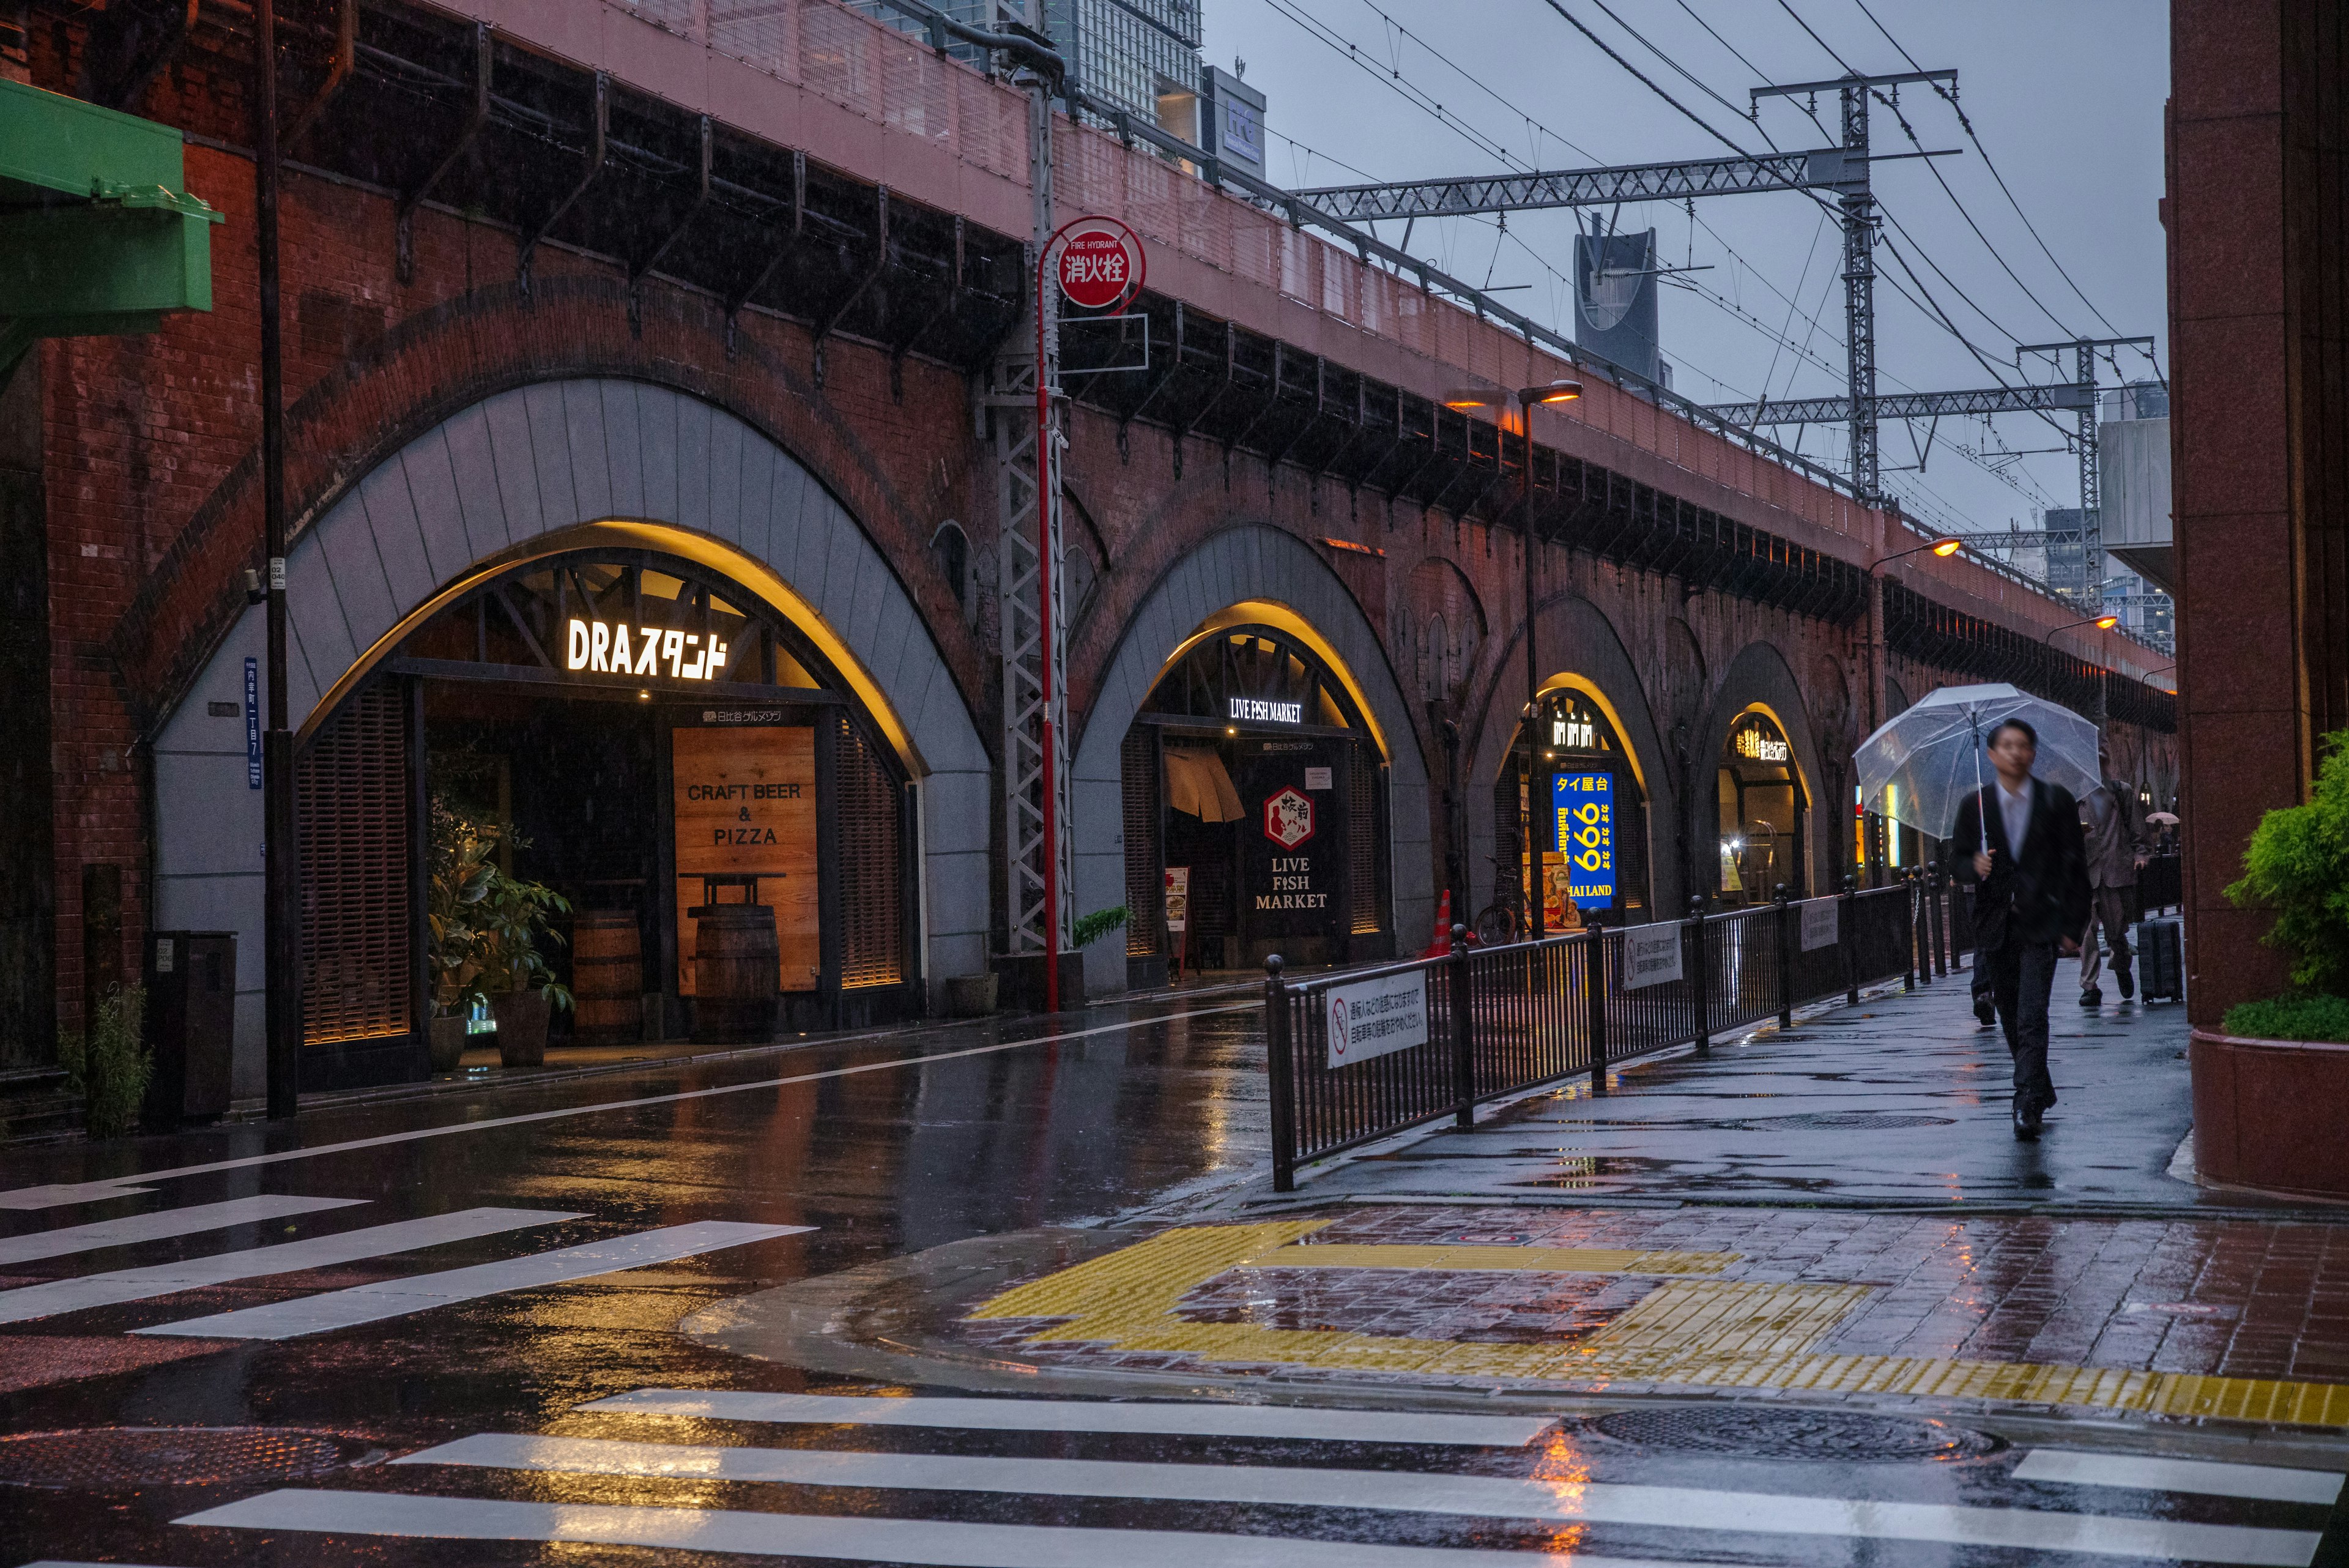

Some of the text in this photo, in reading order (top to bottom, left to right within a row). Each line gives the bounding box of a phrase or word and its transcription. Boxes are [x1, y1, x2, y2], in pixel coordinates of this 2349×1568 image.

[1228, 99, 1255, 143] FPG
[1071, 240, 1118, 250] FIRE HYDRANT
[1065, 253, 1125, 283] 消火栓
[718, 711, 782, 722] 日比谷グルメゾン
[1231, 698, 1250, 718] LIVE
[1269, 702, 1301, 723] MARKET
[688, 783, 801, 801] CRAFT BEER
[1557, 776, 1608, 792] タイ屋台
[738, 806, 751, 822] &
[1282, 794, 1308, 820] 板前
[1287, 816, 1307, 833] バル
[714, 828, 777, 845] PIZZA
[1573, 802, 1601, 872] 999
[1272, 858, 1310, 872] LIVE
[1273, 875, 1310, 890] FISH
[1567, 885, 1612, 897] HAILAND
[1256, 894, 1327, 909] MARKET
